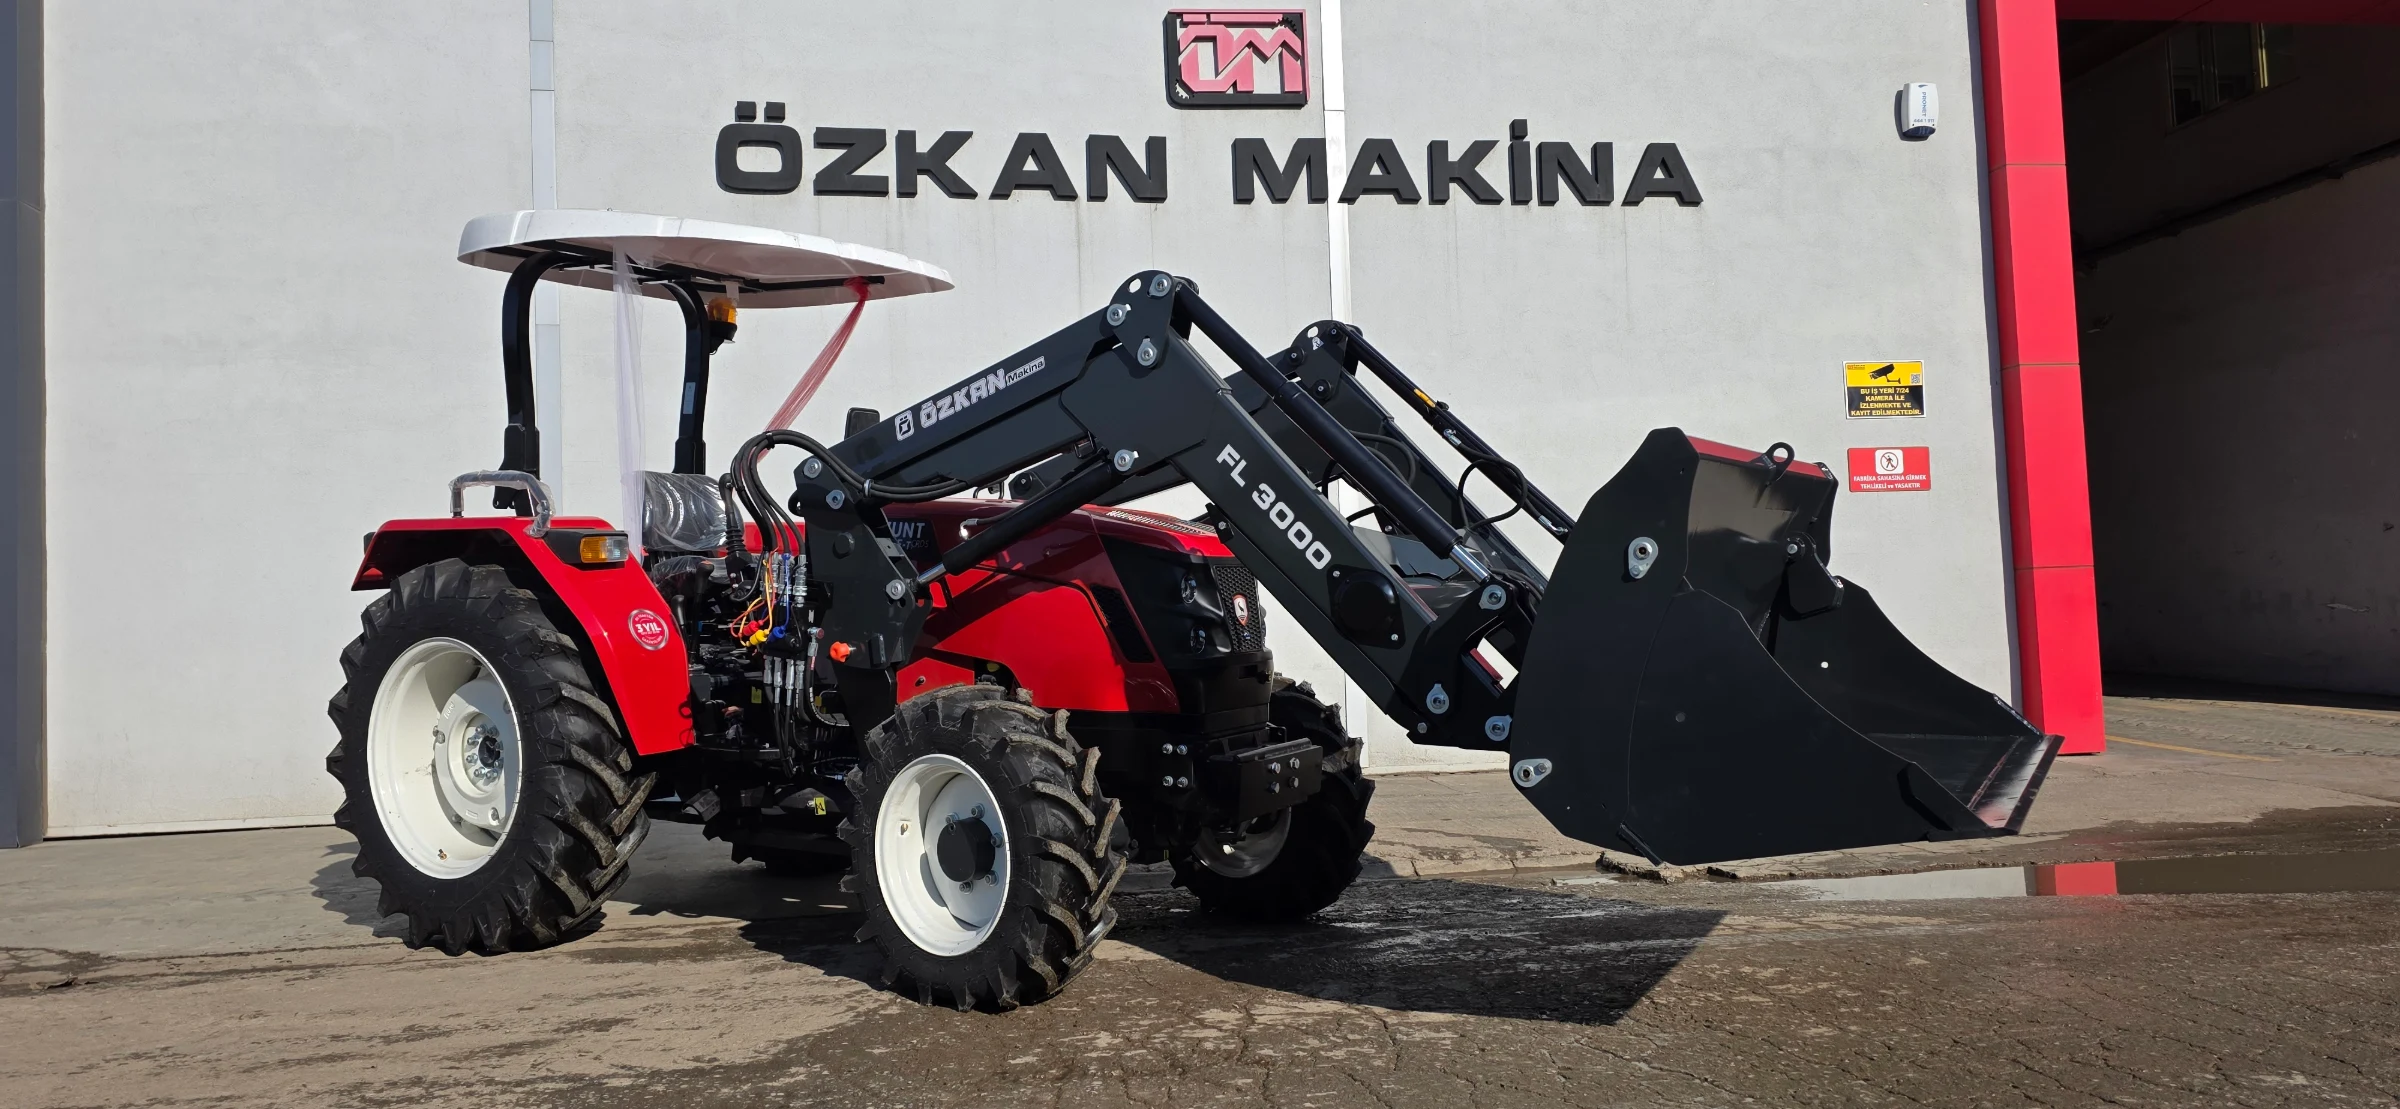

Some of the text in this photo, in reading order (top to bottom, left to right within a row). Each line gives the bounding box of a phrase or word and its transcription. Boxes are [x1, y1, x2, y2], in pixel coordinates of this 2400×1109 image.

[715, 101, 1704, 207] ÖZKAN MAKİNA
[920, 368, 1006, 429] ÖZKAN
[1007, 357, 1045, 385] Makina
[1871, 387, 1878, 395] İŞ
[1216, 443, 1332, 569] FL 3000
[635, 623, 644, 633] 3
[642, 622, 662, 632] YIL
